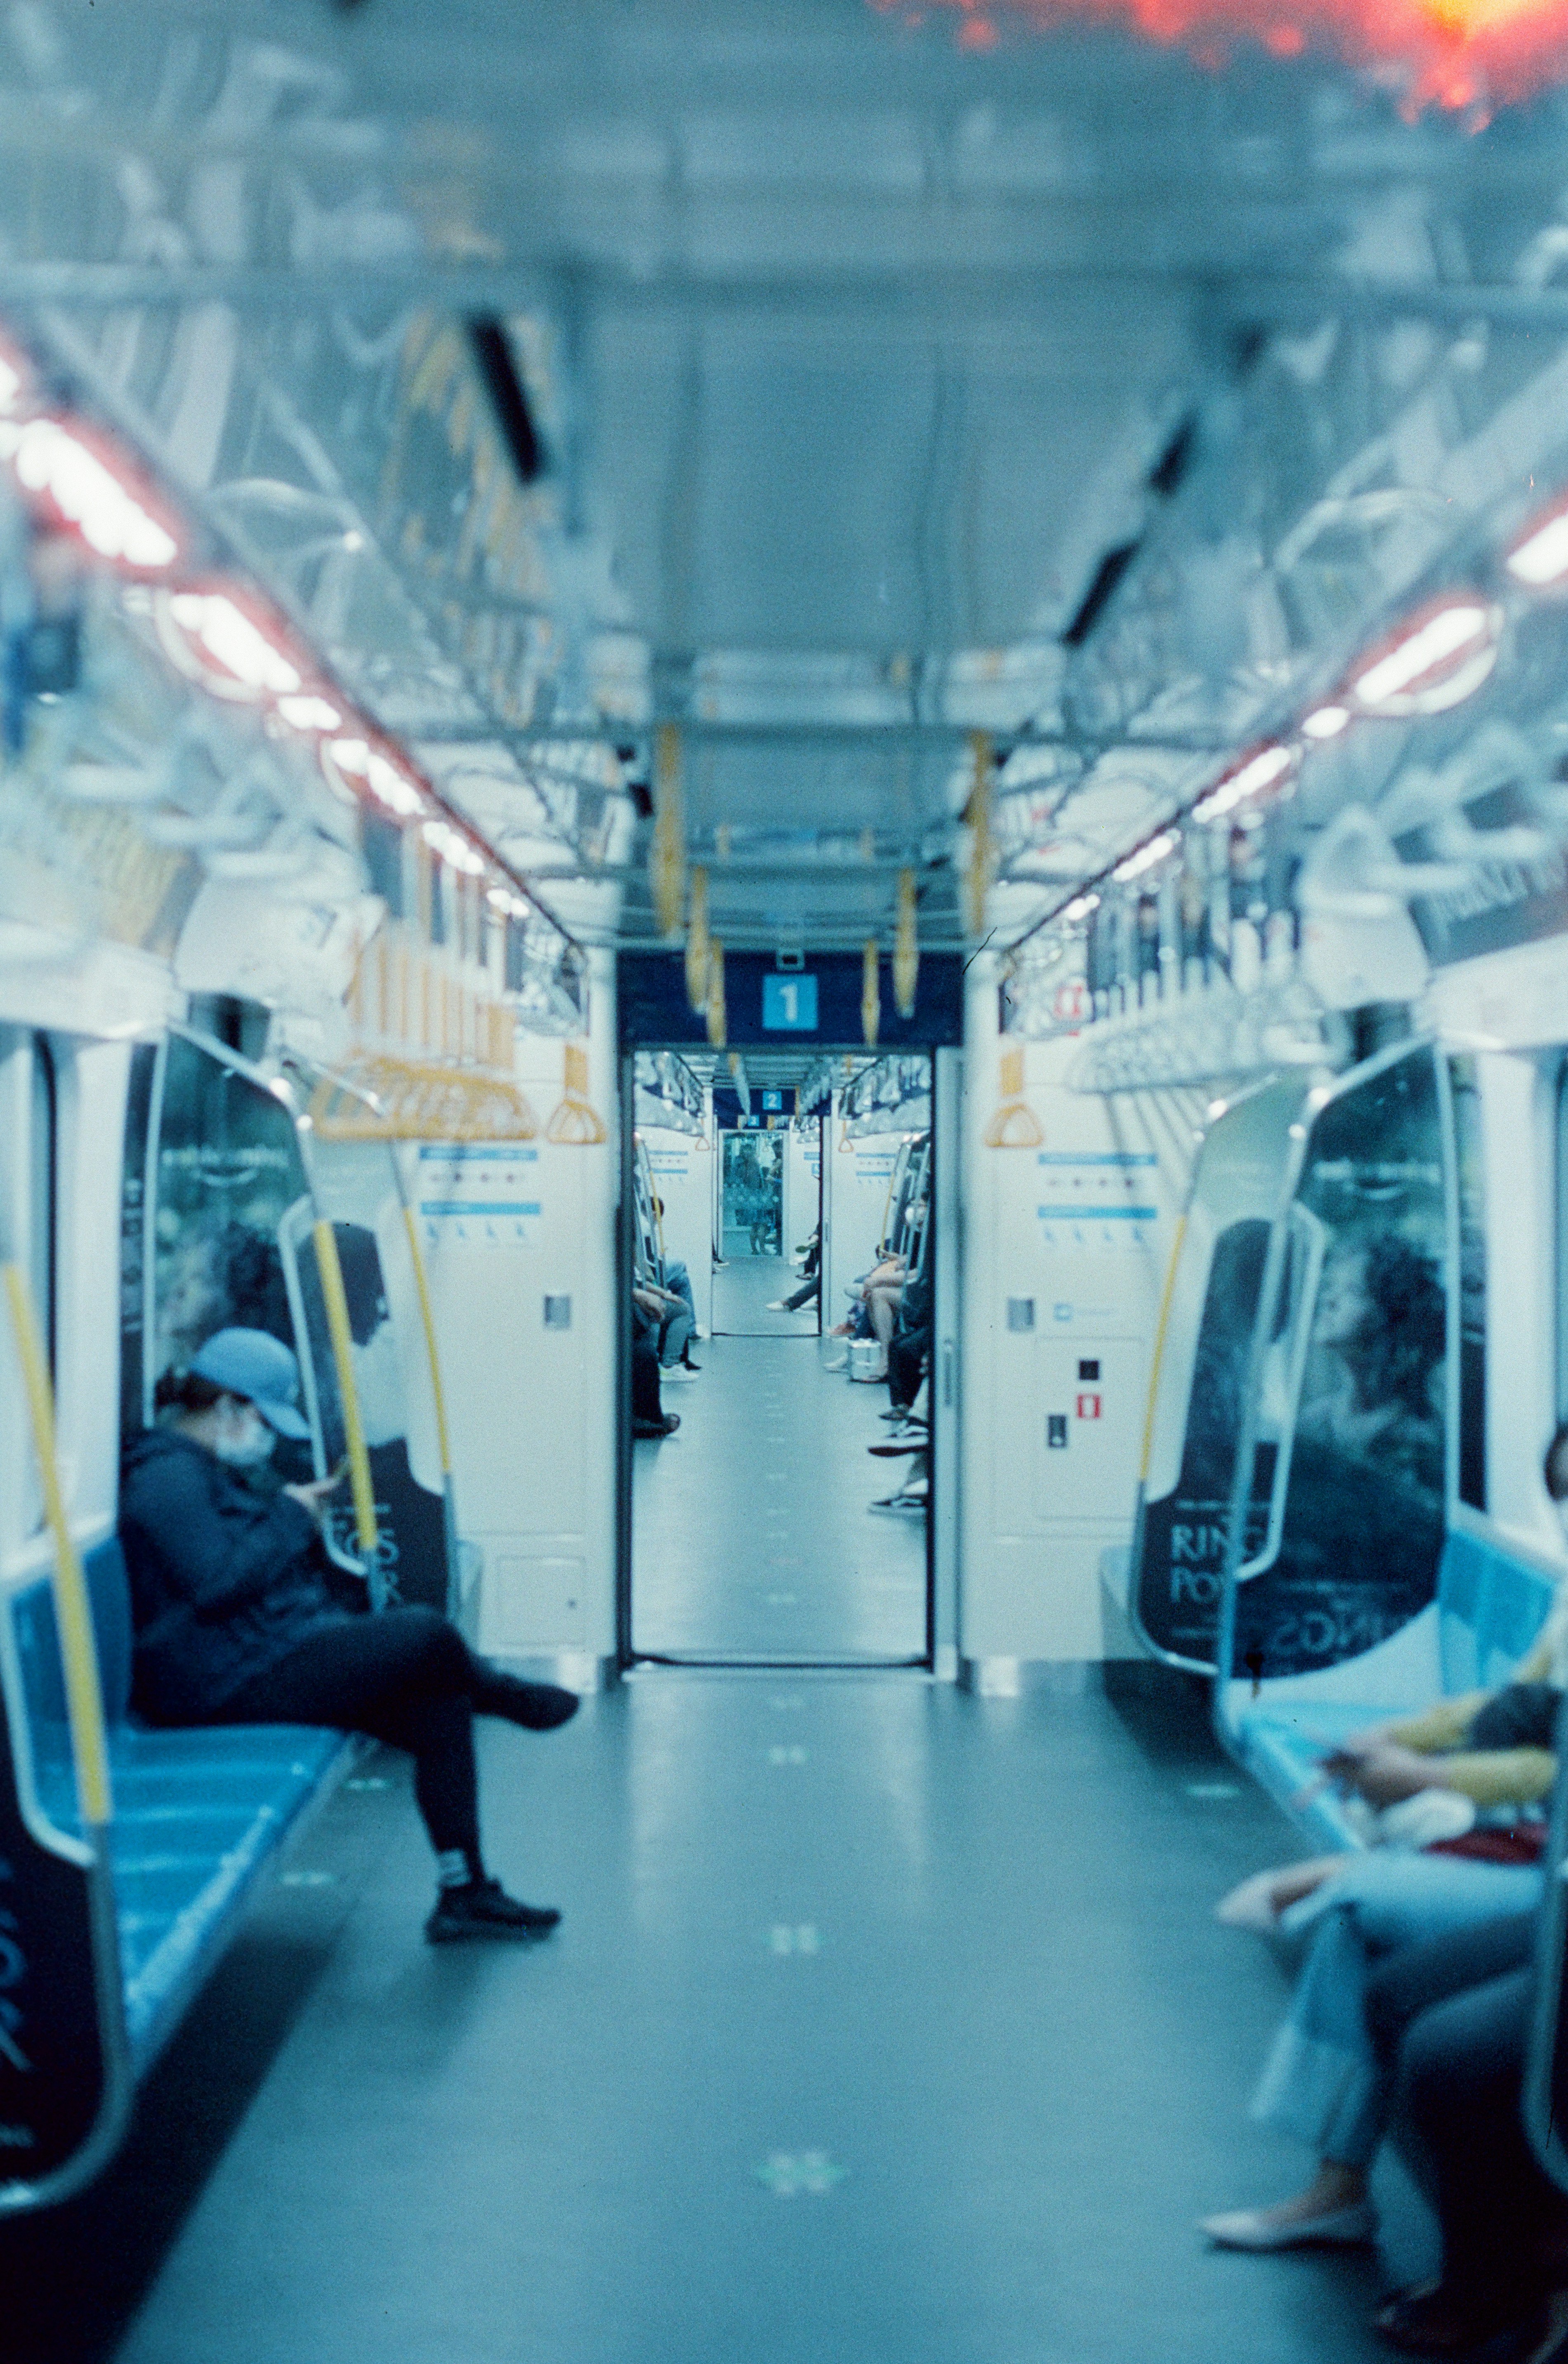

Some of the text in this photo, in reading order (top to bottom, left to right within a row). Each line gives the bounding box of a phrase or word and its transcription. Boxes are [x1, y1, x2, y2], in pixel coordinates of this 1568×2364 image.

[779, 983, 798, 1023] 1
[768, 1093, 777, 1108] 2
[750, 1116, 757, 1126] 3
